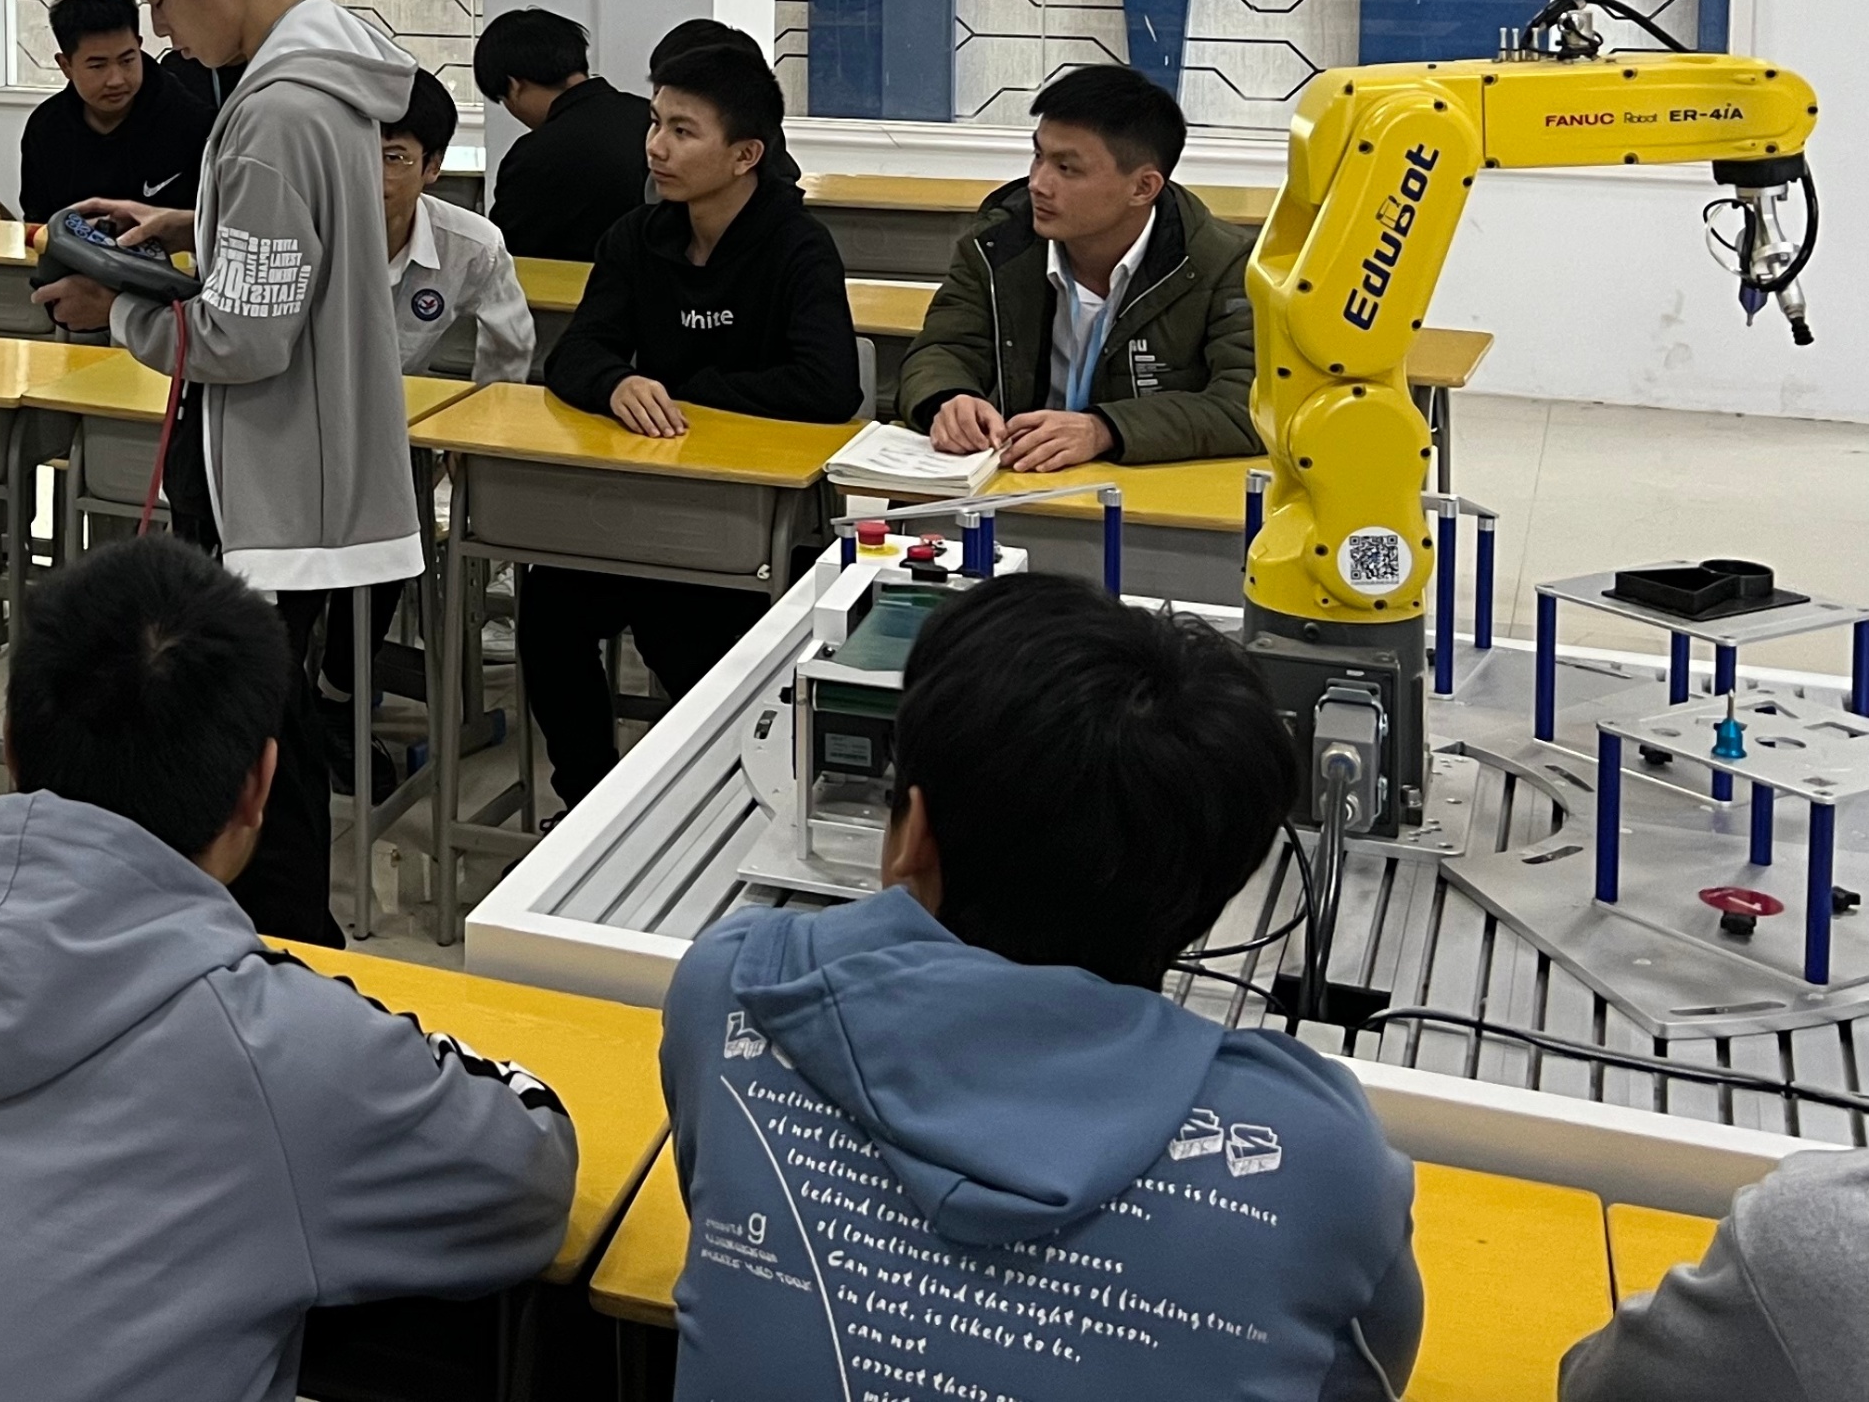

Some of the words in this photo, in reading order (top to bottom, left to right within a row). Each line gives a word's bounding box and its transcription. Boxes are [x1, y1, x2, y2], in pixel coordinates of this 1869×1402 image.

[1545, 113, 1615, 127] FANUC
[1624, 112, 1658, 124] Robot
[1343, 143, 1440, 330] EduBot
[1209, 1189, 1278, 1226] because
[876, 1268, 914, 1289] not
[917, 1273, 966, 1304] find
[974, 1288, 1009, 1314] the
[837, 1285, 859, 1303] in
[924, 1307, 943, 1326] is
[949, 1313, 1016, 1349] likely
[1022, 1332, 1045, 1352] to
[847, 1322, 883, 1344] can
[890, 1333, 928, 1355] not
[851, 1355, 927, 1388] correct
